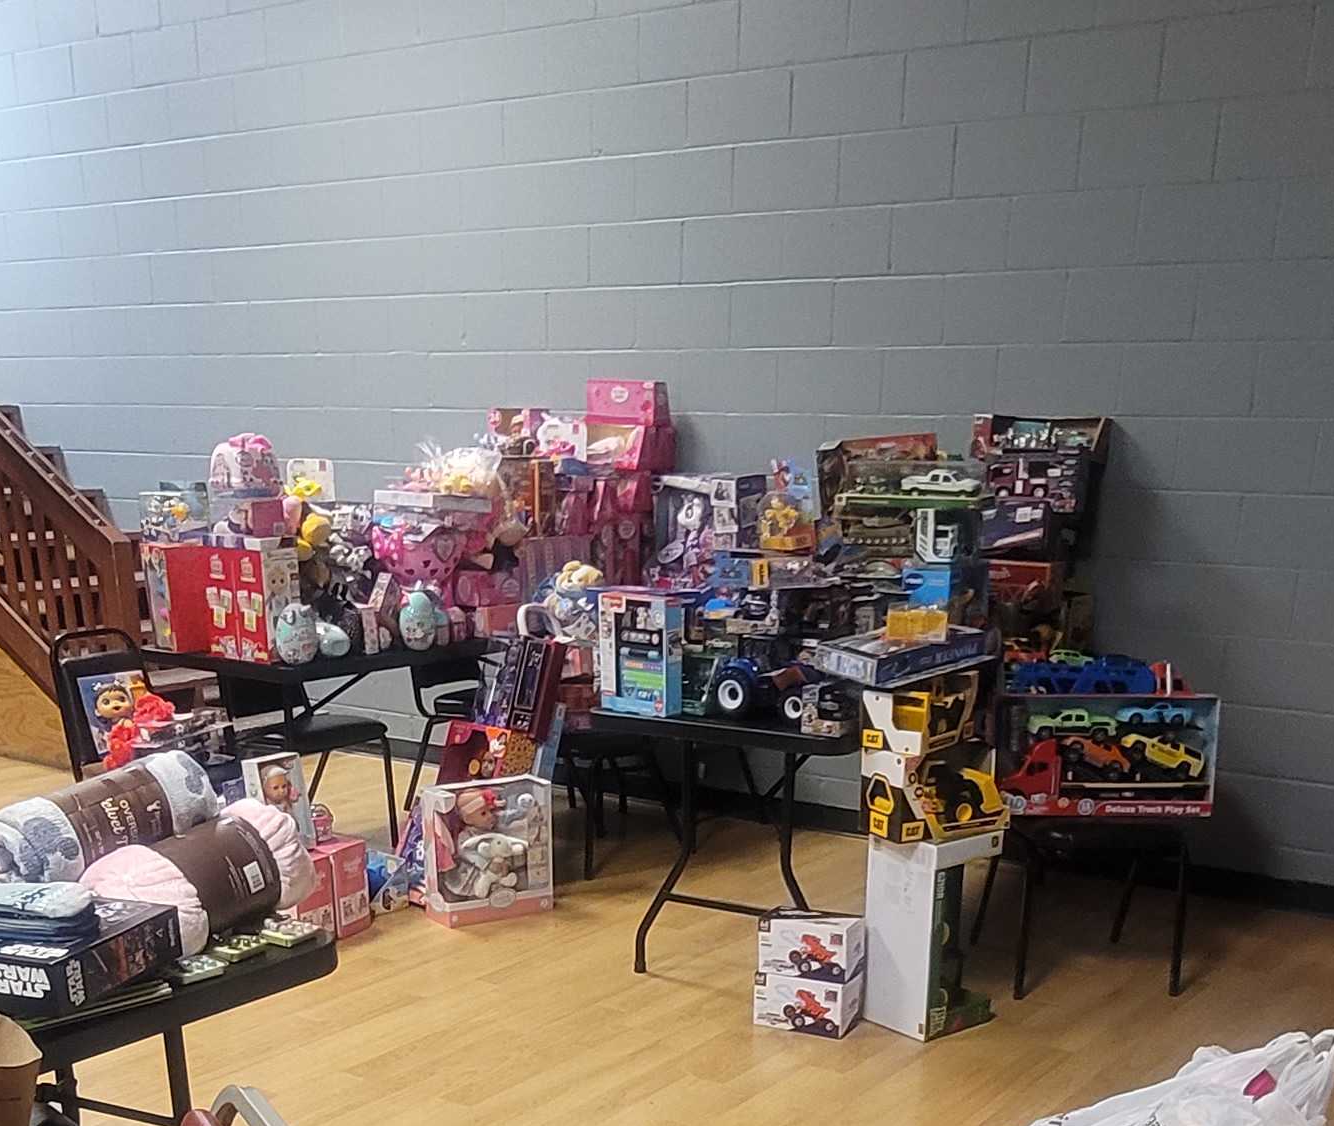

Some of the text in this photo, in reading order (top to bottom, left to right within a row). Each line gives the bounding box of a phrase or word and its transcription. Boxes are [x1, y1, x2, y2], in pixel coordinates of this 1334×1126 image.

[866, 734, 879, 743] CAT
[1105, 805, 1201, 816] Deluxe Truck Play Set
[100, 798, 126, 835] elvet
[873, 818, 884, 830] CAT
[906, 826, 920, 836] CAT
